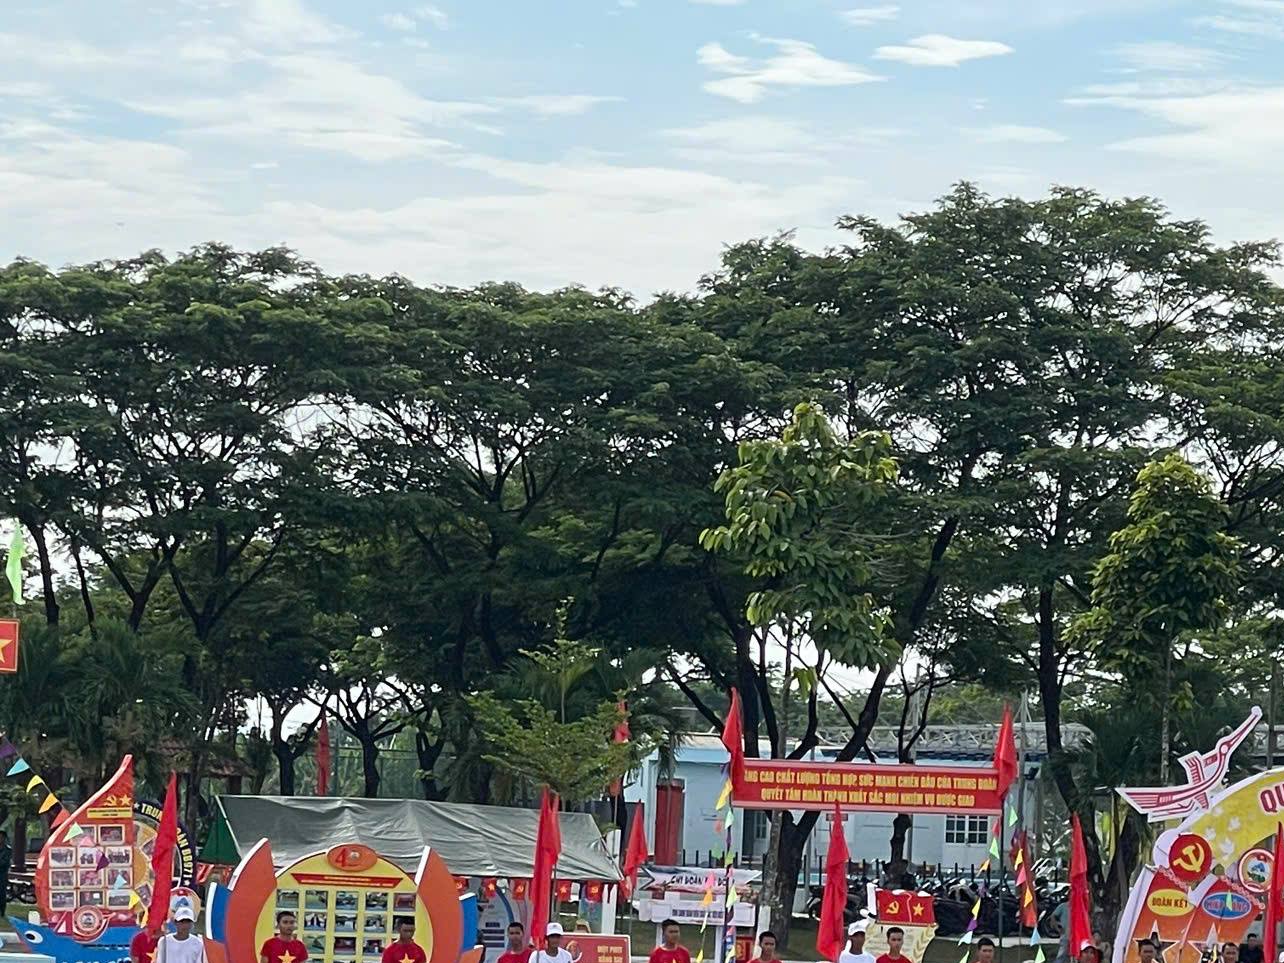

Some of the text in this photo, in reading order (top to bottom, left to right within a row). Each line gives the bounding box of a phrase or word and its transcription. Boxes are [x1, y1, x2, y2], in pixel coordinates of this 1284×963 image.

[760, 770, 774, 783] CAO
[776, 769, 795, 784] CHẤT
[953, 777, 976, 790] TRUNG
[761, 785, 784, 800] QUYẾT
[958, 794, 975, 806] GIAO
[1152, 896, 1188, 908] ĐOÀN KẾT
